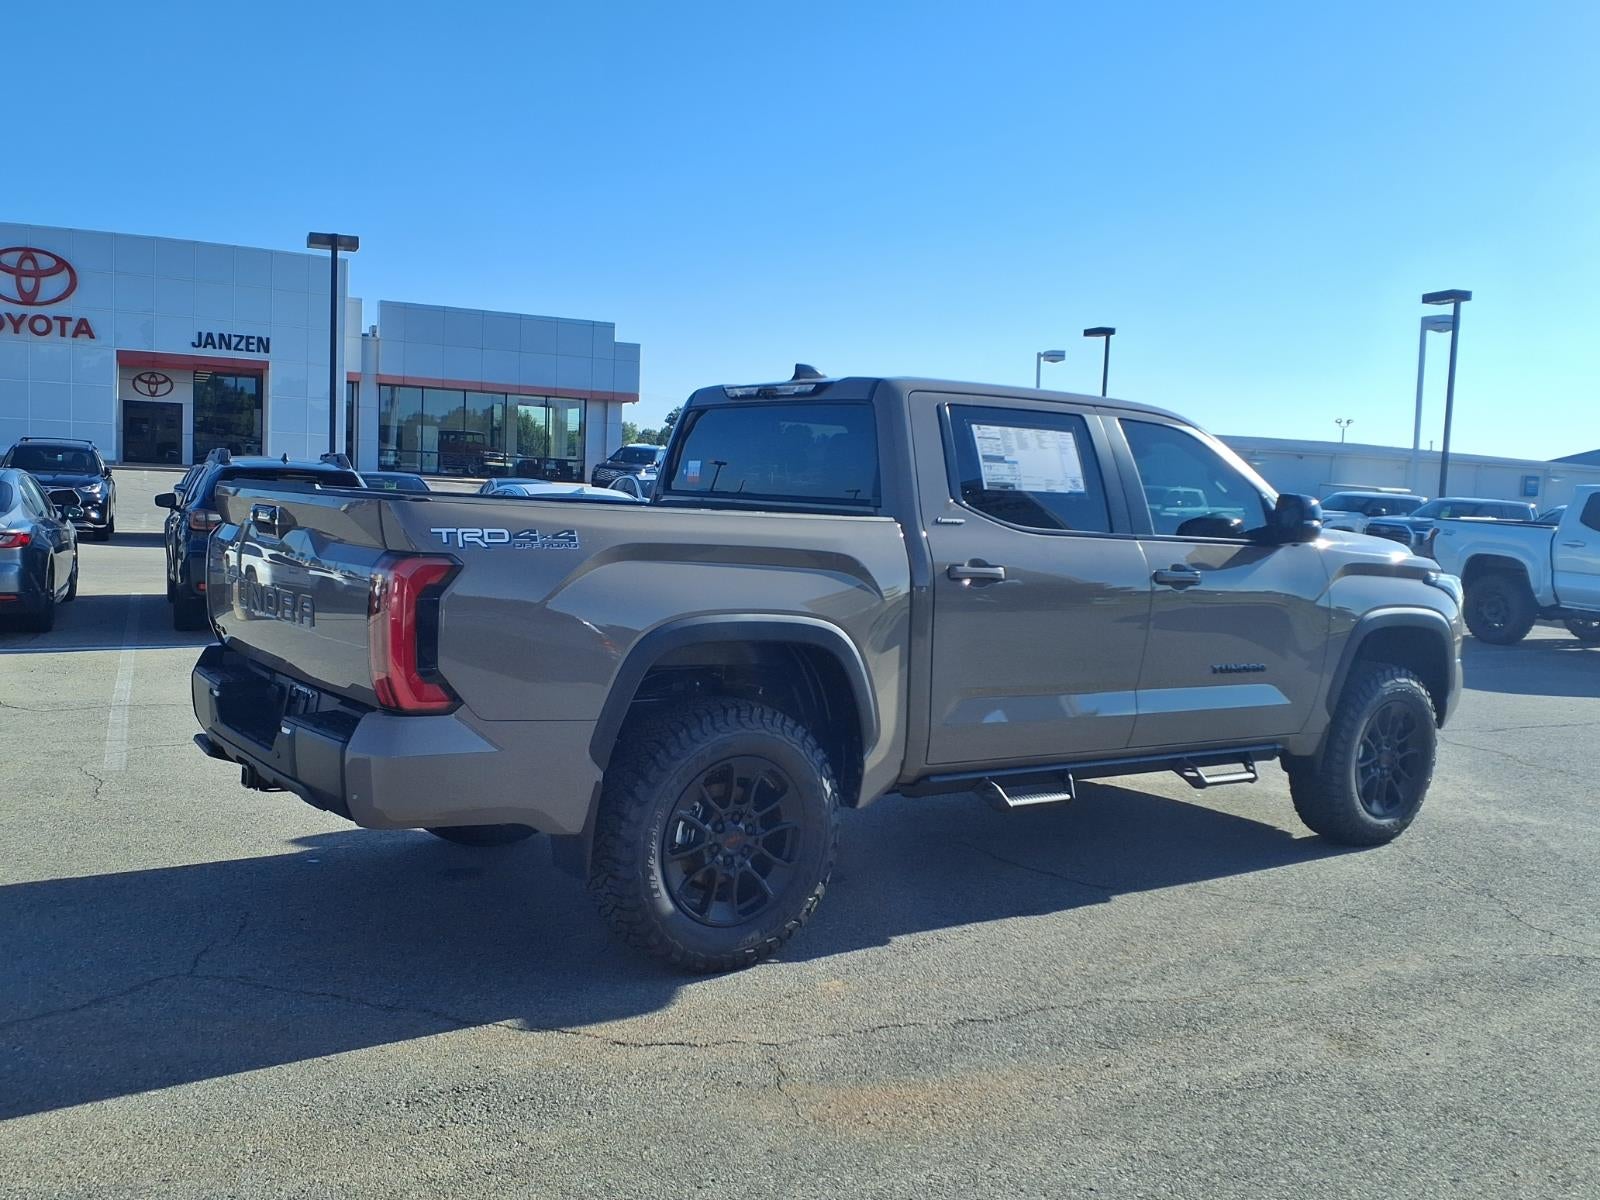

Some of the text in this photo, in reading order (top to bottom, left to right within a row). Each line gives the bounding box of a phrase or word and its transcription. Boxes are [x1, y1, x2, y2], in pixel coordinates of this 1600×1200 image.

[0, 312, 96, 339] YOTA
[191, 331, 271, 354] JANZEN
[430, 527, 511, 549] TRD
